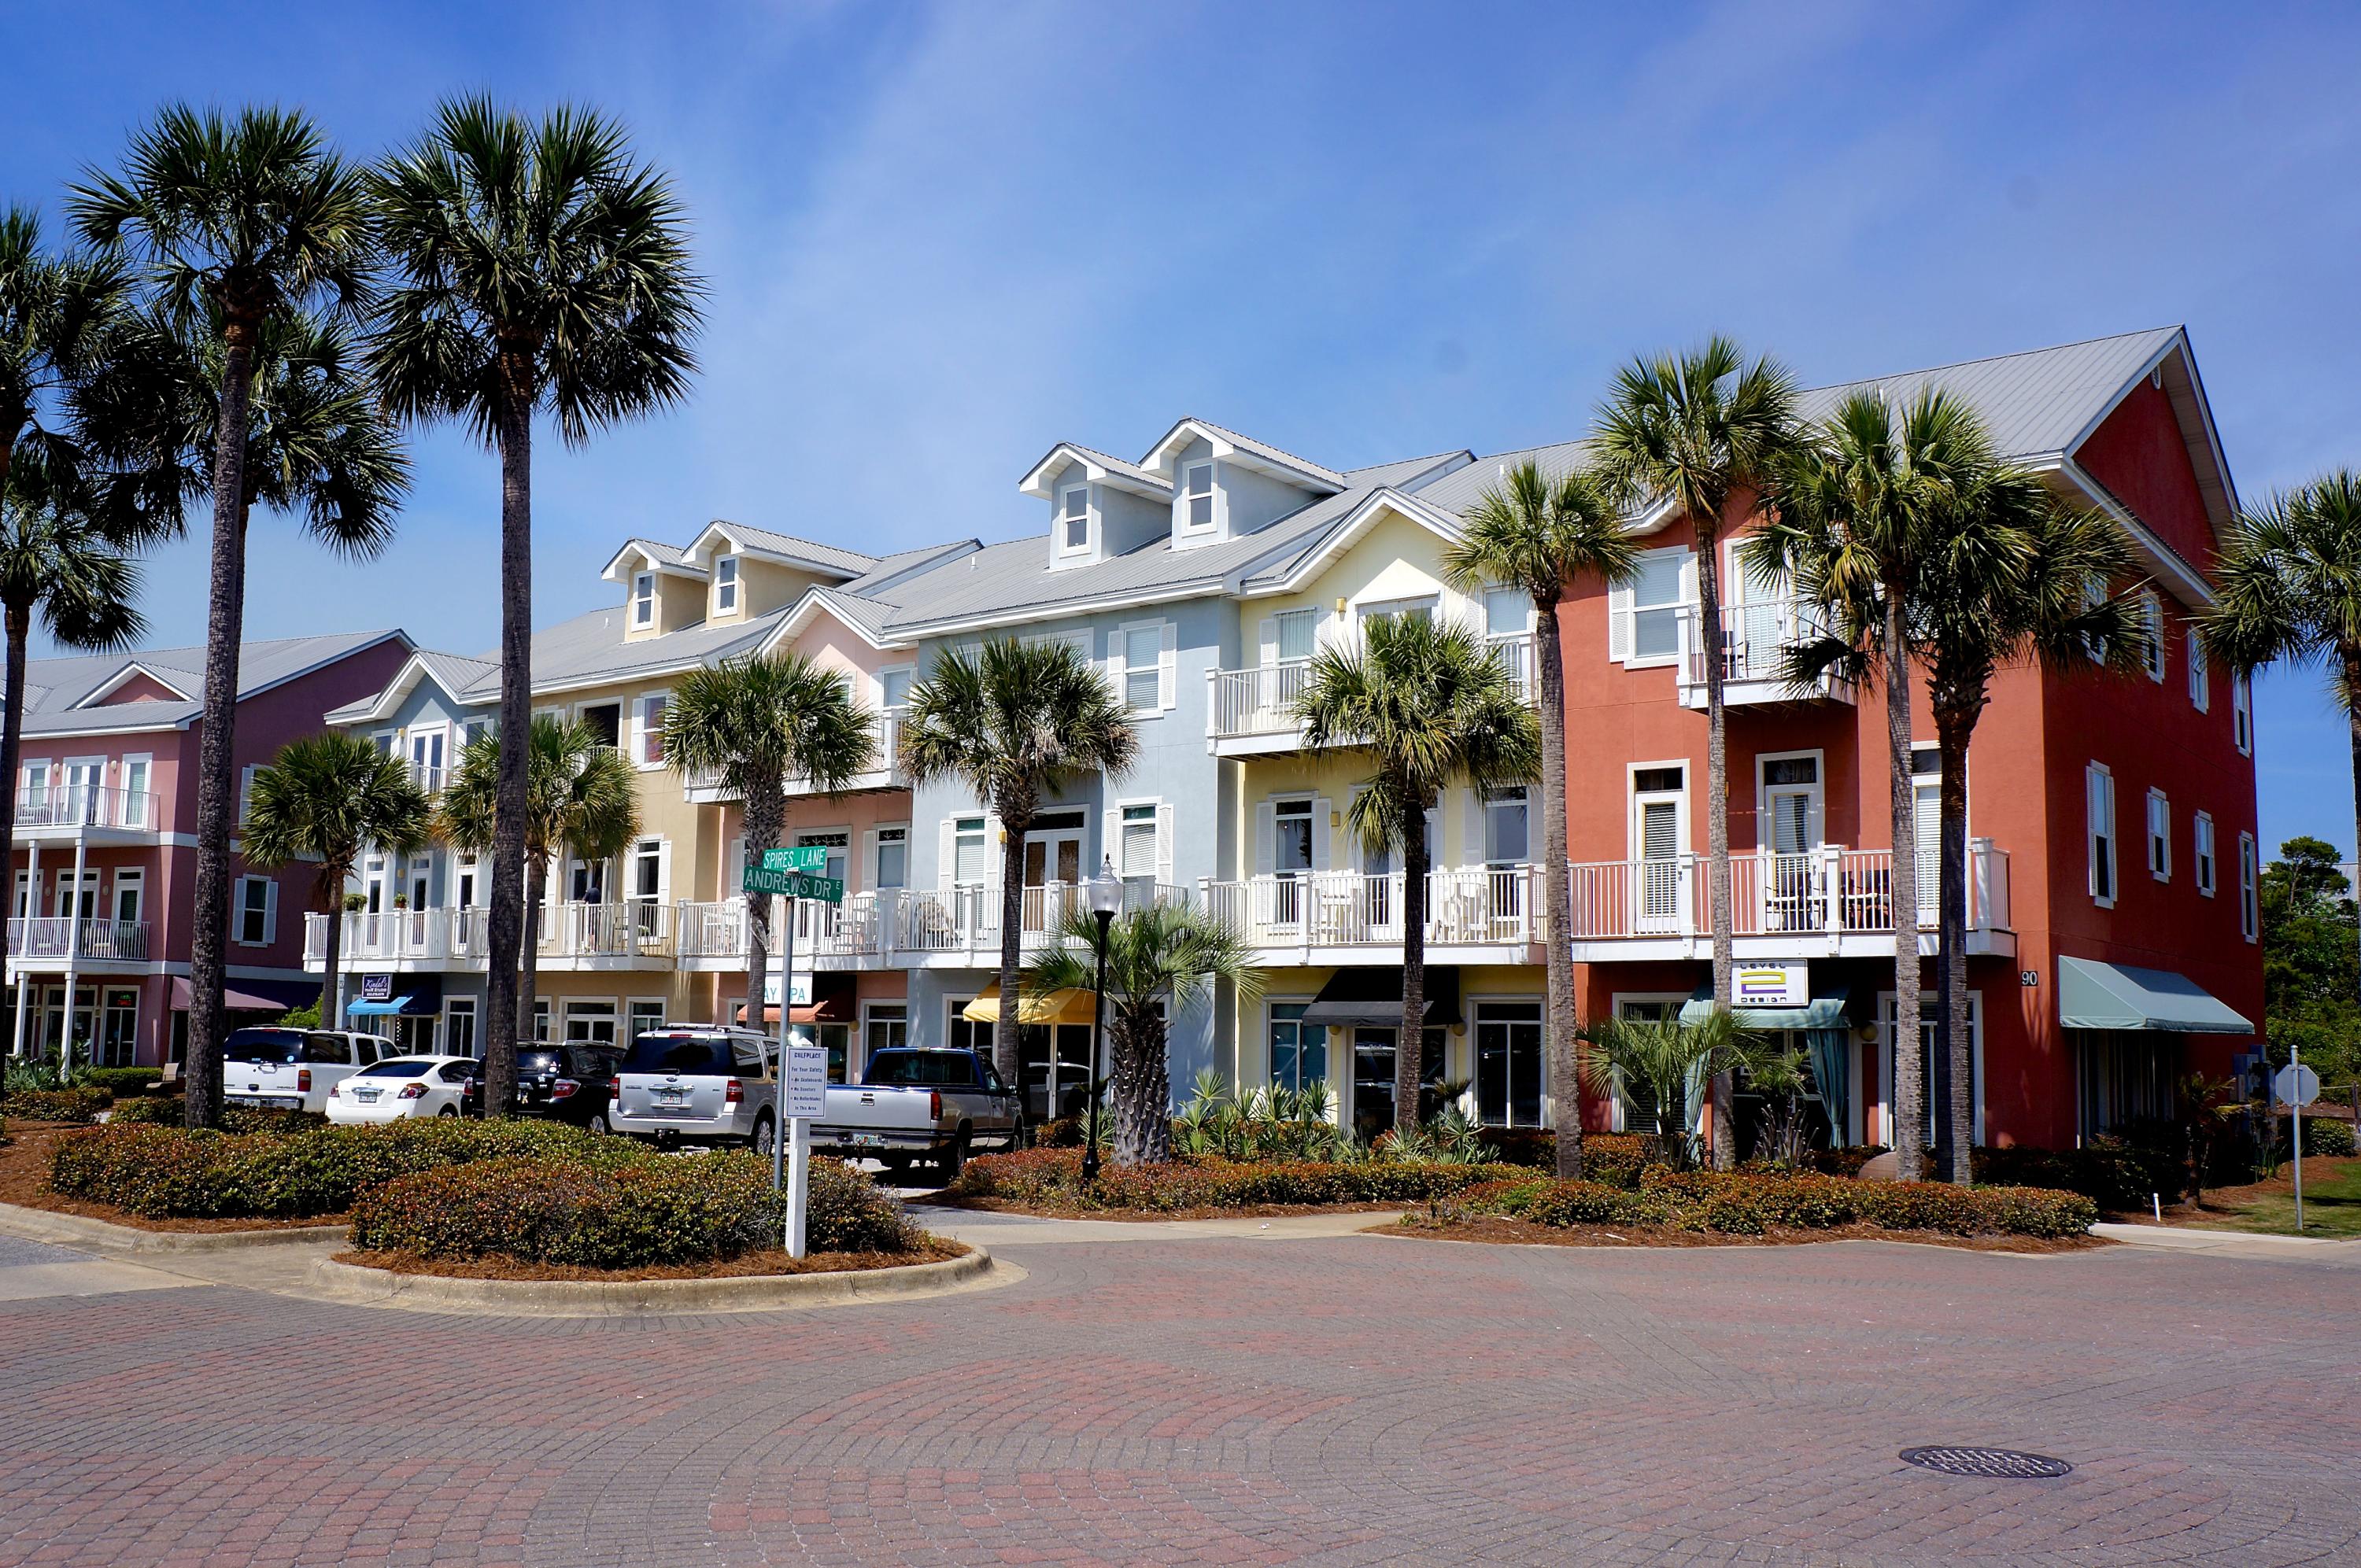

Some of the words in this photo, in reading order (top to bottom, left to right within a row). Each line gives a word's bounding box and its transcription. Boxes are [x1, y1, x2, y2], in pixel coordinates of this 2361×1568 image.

[763, 850, 794, 869] SPIRES
[800, 849, 826, 867] LANE
[745, 869, 810, 895] ANDREWS
[813, 880, 832, 898] DR
[835, 881, 841, 890] E
[1740, 972, 1786, 994] 2
[2022, 972, 2038, 985] 90
[764, 987, 778, 1002] AY
[789, 987, 807, 1002] PA
